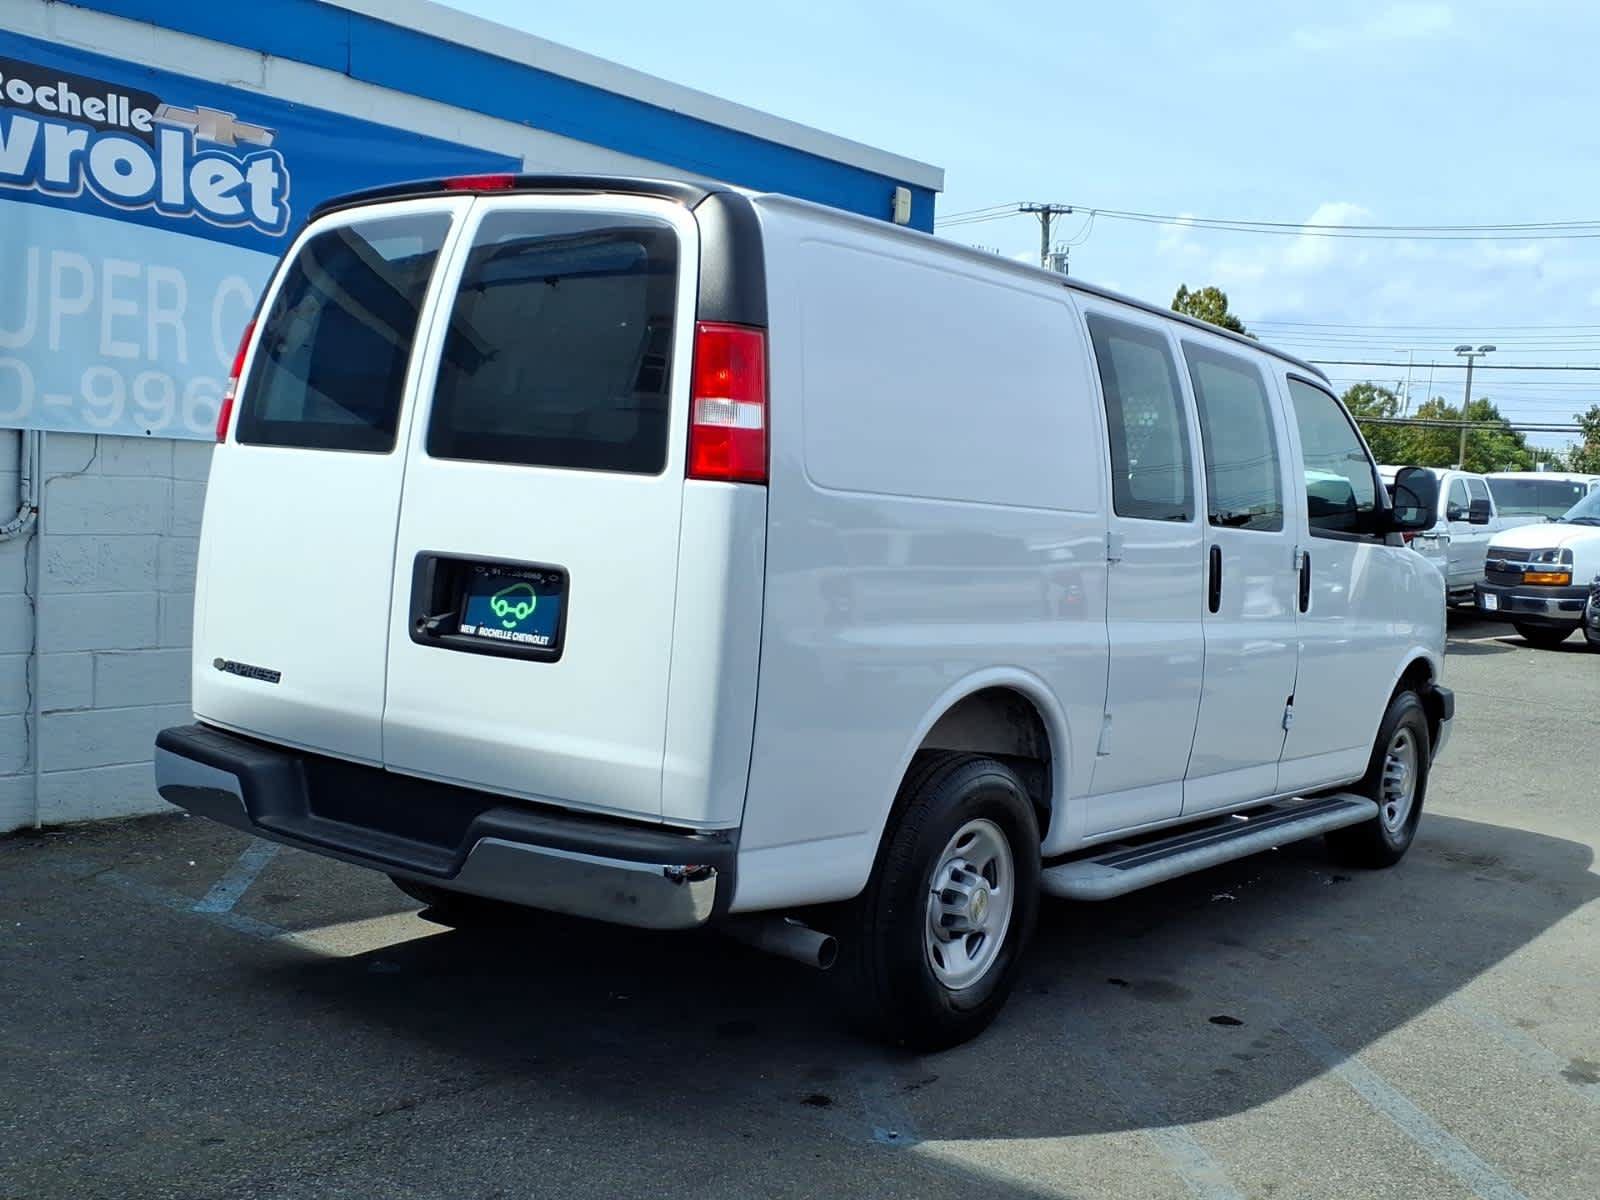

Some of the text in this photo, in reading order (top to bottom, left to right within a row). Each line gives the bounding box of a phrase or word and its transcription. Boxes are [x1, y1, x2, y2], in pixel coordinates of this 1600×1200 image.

[0, 72, 153, 132] ochelle
[461, 624, 549, 645] NEW ROCHELLE CHEVROLET
